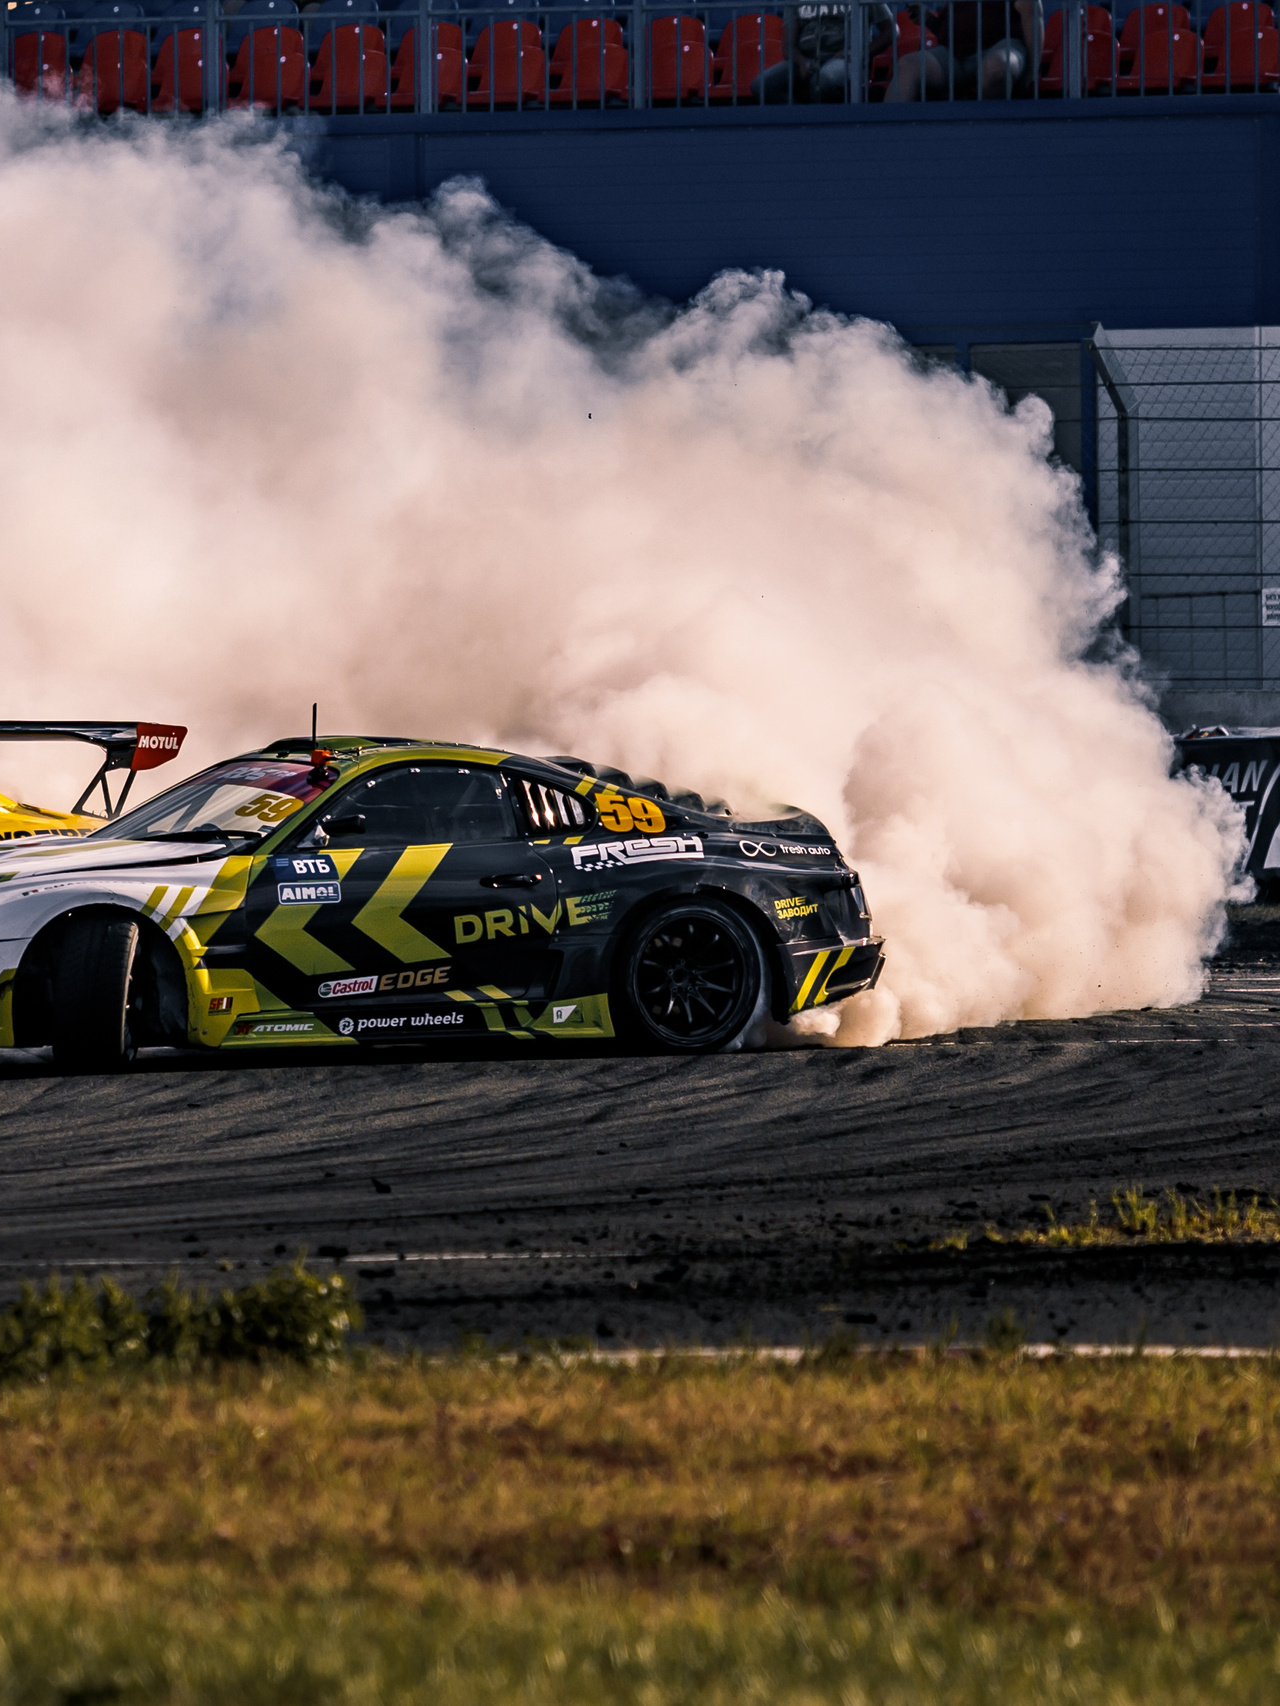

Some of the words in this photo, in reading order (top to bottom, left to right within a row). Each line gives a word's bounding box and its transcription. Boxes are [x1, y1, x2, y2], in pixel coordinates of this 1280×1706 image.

[138, 735, 179, 750] MOTUL
[235, 794, 304, 822] 59
[595, 793, 666, 833] 59
[780, 844, 807, 854] fresh
[808, 846, 831, 855] auto
[292, 858, 330, 875] ВТБ
[281, 886, 338, 901] AIMOL
[774, 896, 807, 909] DRIVE
[453, 890, 610, 944] DRIVE
[776, 903, 819, 919] ЗАВОДИТ
[332, 978, 375, 995] Castrol
[378, 966, 452, 991] EDGE
[253, 1024, 314, 1032] ATOMIC
[357, 1016, 407, 1031] power
[410, 1012, 464, 1027] wheels
